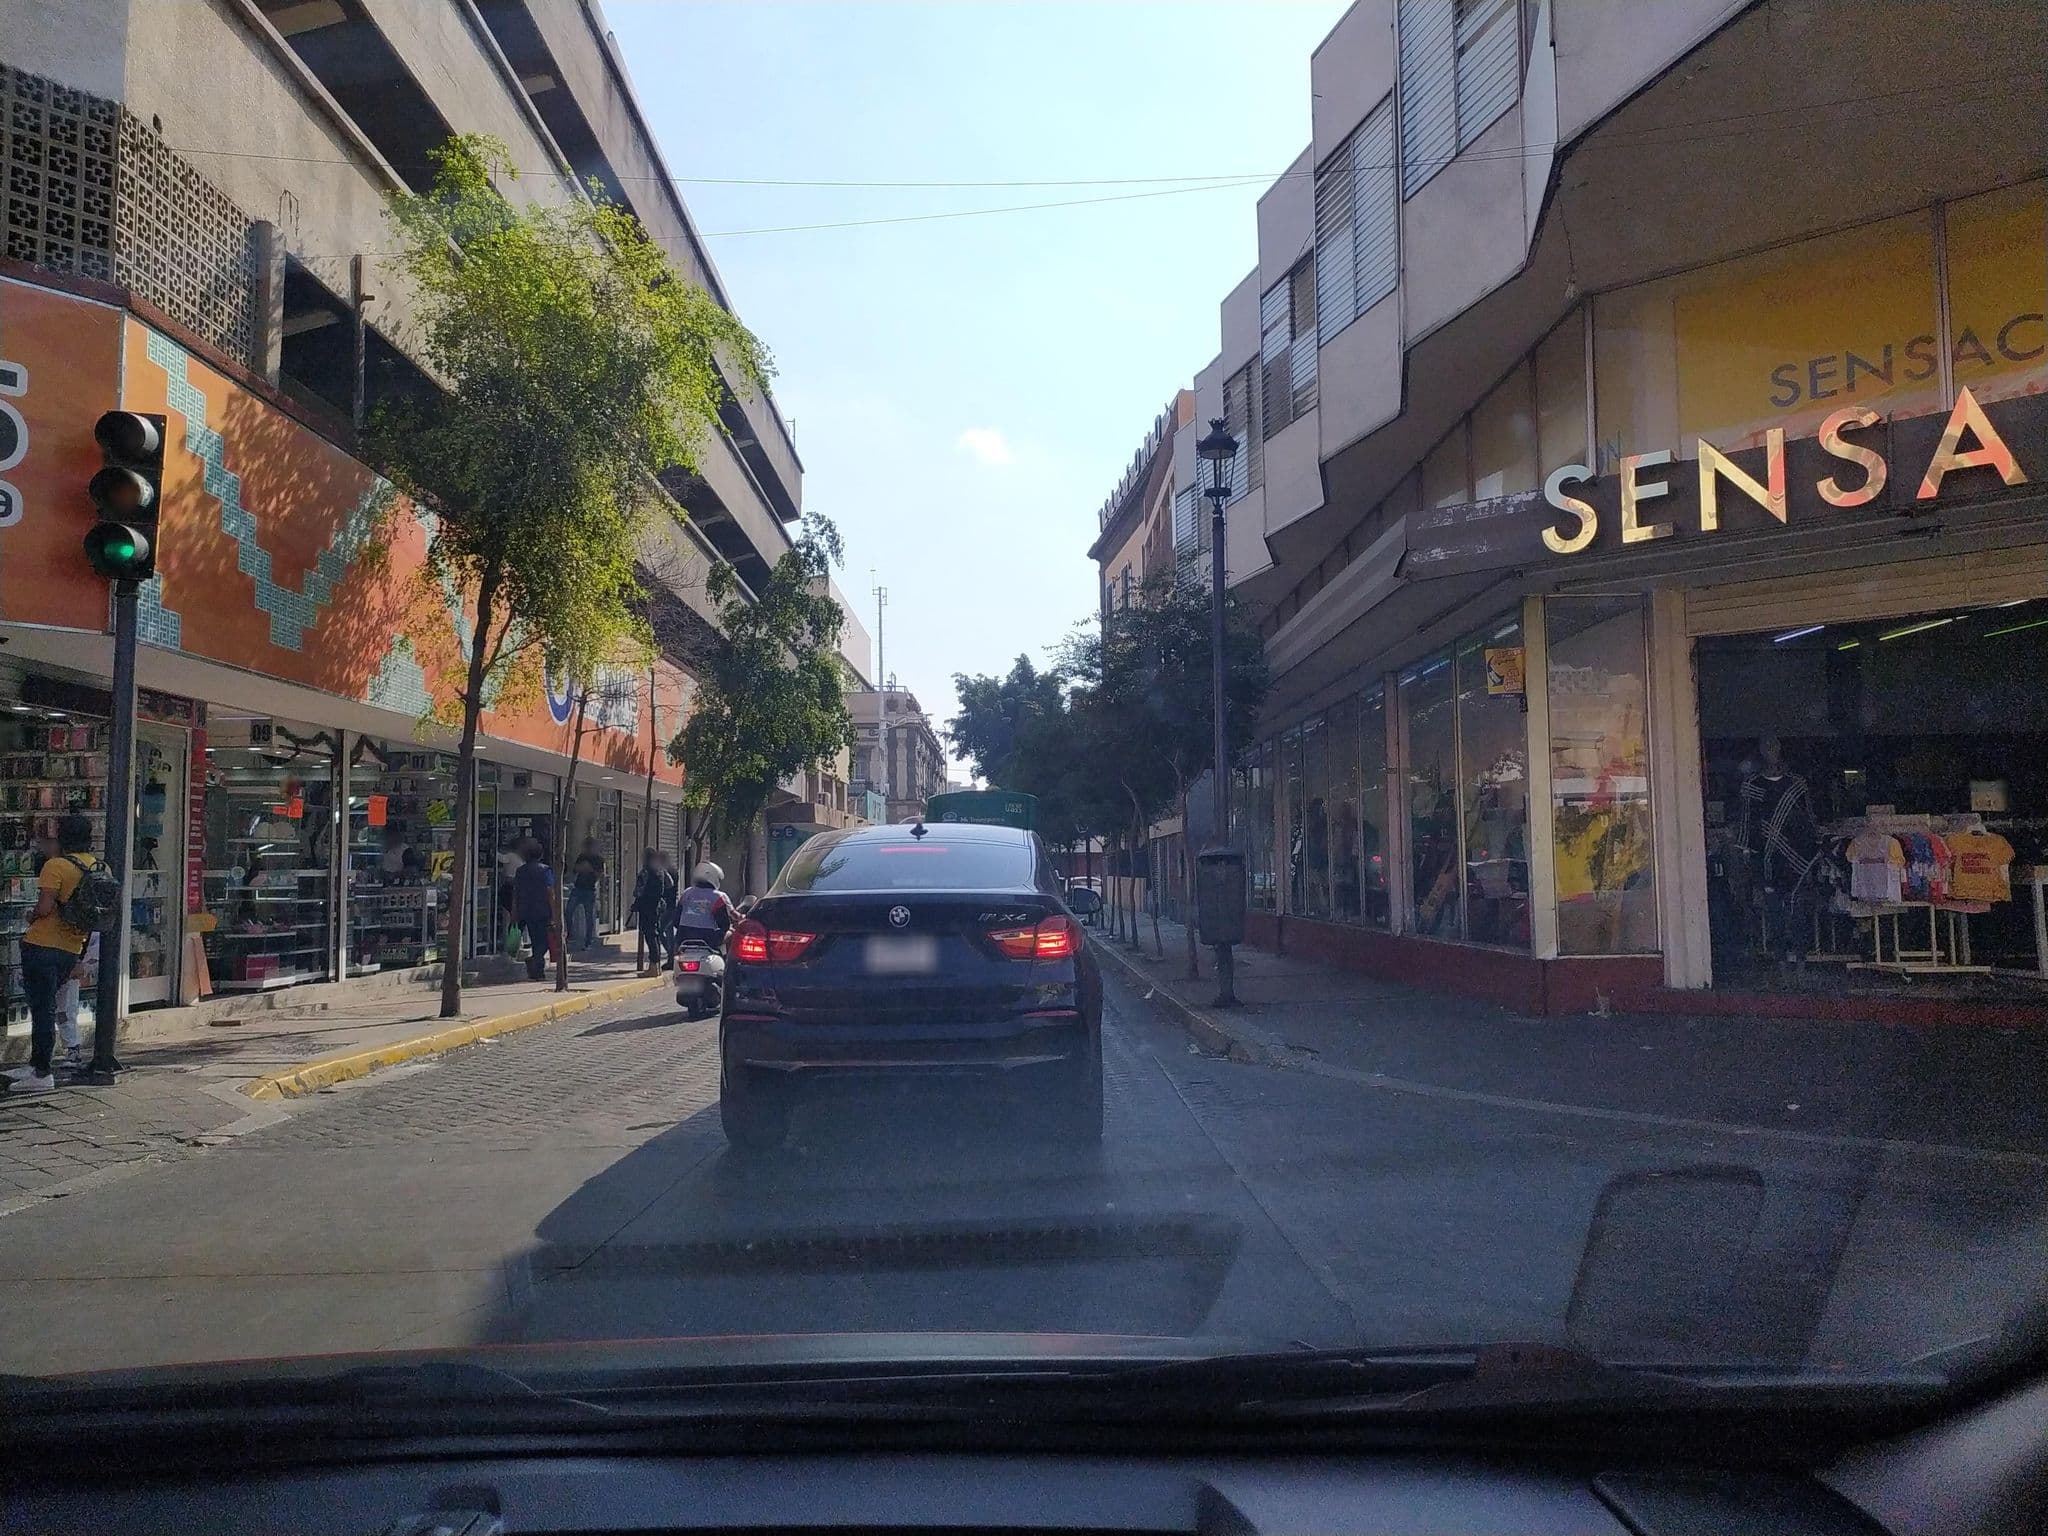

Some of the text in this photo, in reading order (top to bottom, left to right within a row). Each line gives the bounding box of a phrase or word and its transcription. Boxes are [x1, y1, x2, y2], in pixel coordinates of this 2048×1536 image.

[1768, 312, 2045, 408] SENSAC
[1541, 385, 2029, 554] SENSA
[785, 828, 793, 837] E
